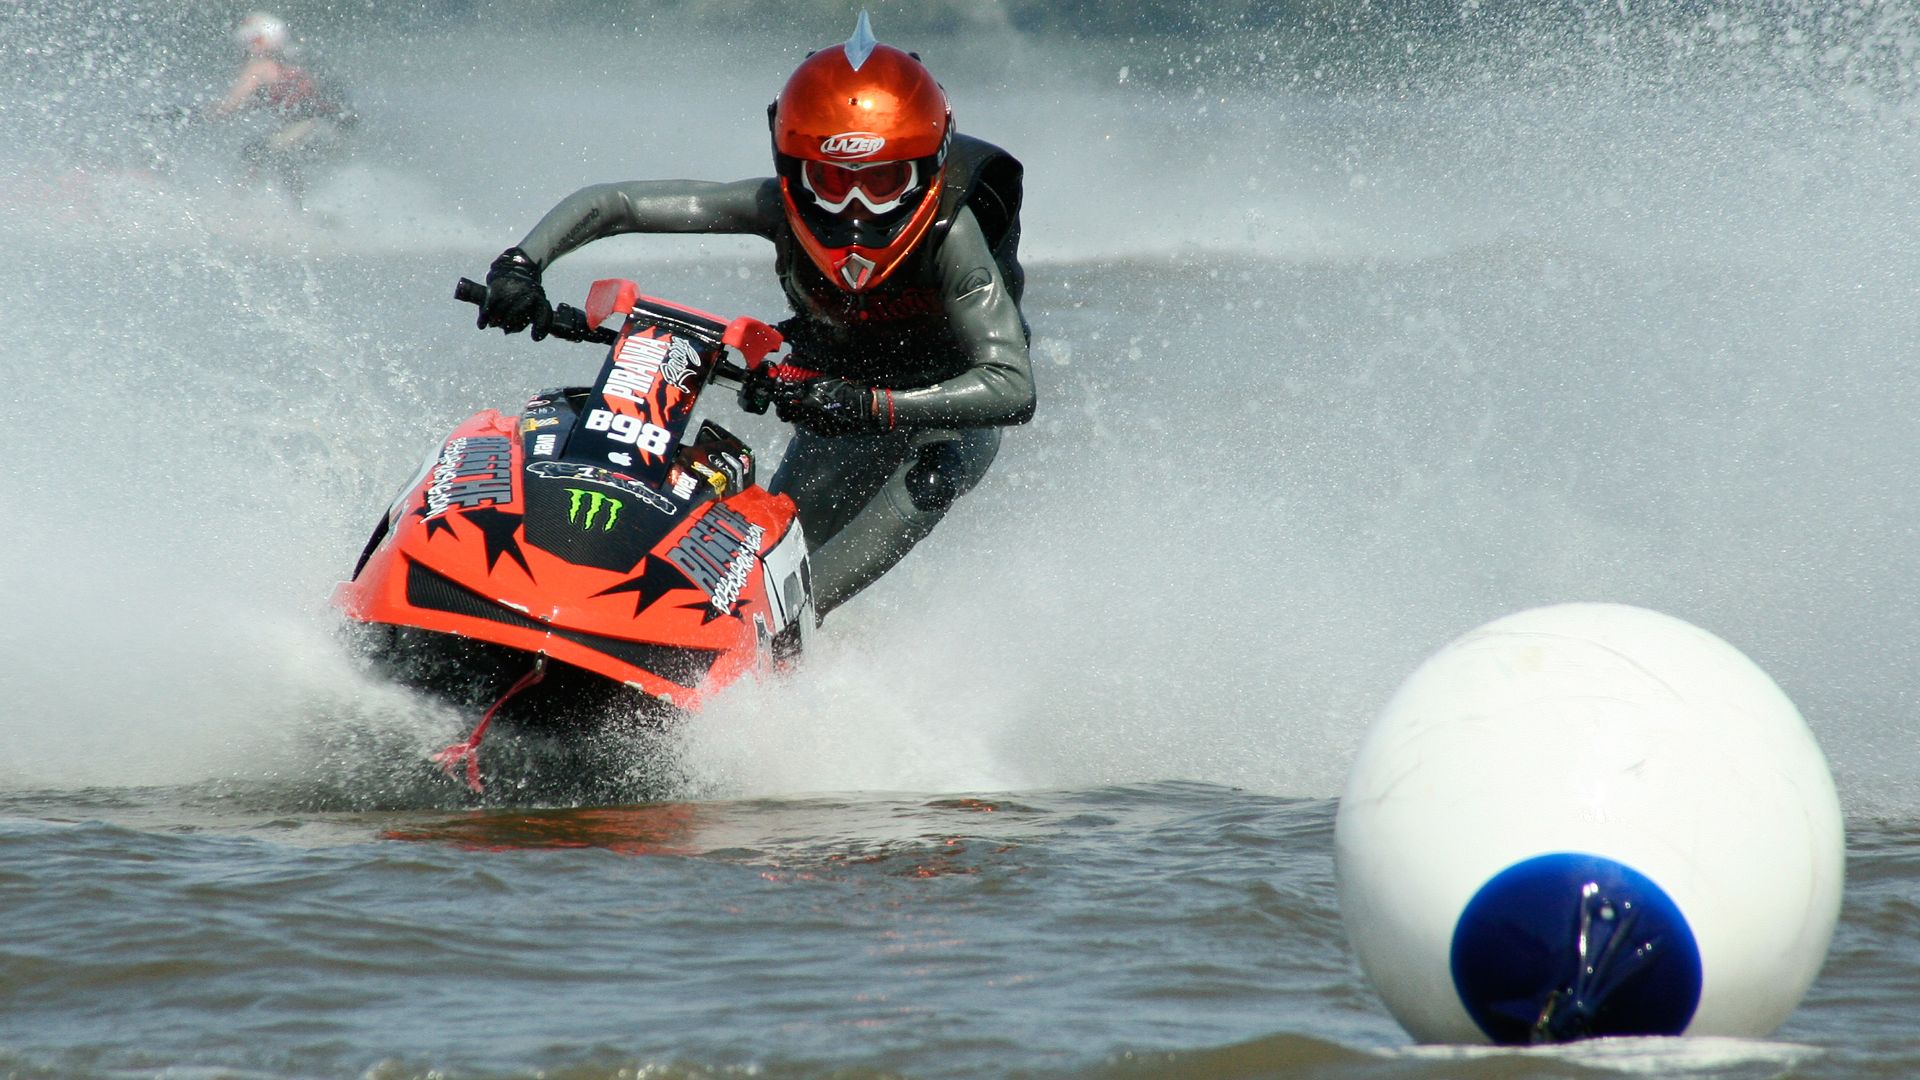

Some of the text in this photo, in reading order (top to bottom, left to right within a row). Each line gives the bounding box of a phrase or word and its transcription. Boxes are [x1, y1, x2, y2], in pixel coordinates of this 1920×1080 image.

[826, 137, 881, 152] LAZER
[604, 335, 670, 404] PIRANHA
[660, 335, 701, 394] Racing
[533, 434, 557, 456] uvex
[585, 409, 671, 456] B98
[672, 471, 699, 500] uvex
